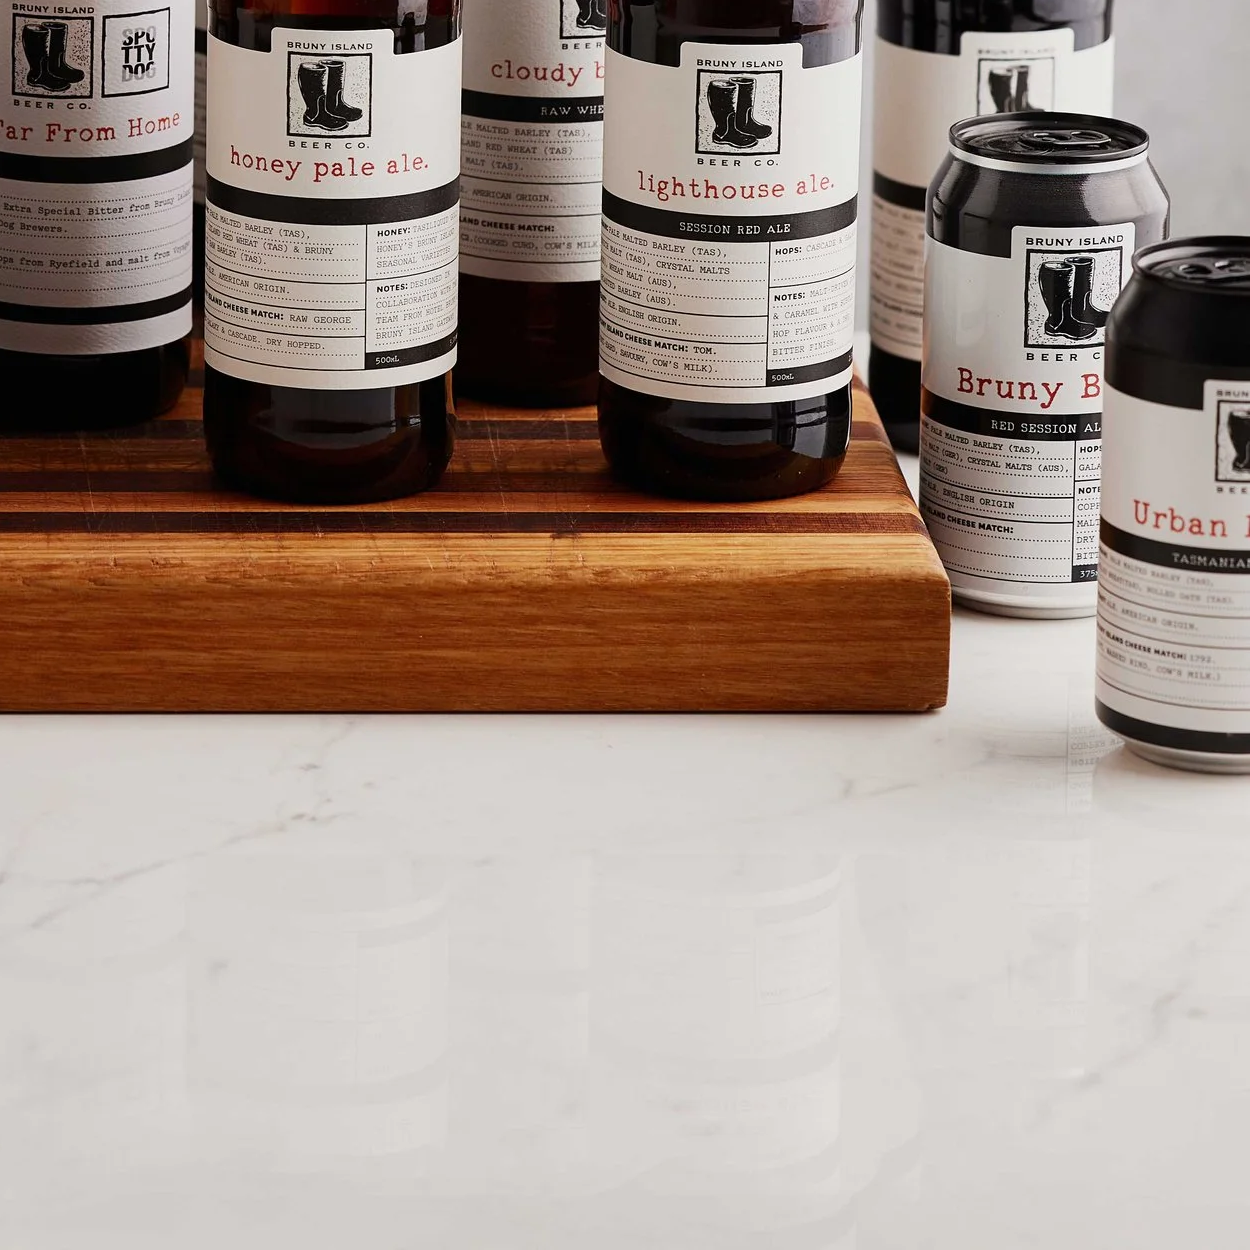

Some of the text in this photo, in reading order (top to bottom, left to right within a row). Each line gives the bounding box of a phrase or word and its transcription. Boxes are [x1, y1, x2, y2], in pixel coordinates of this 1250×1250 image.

[12, 3, 94, 14] BRUNY ISLAND
[121, 26, 156, 45] SPO
[121, 43, 155, 63] TTY
[697, 60, 737, 68] BRUNY
[121, 62, 156, 82] DOG
[491, 60, 583, 87] cloudy
[14, 99, 54, 109] BEER
[541, 105, 604, 115] RAW WHE
[46, 123, 115, 142] From
[127, 113, 180, 137] Home
[477, 124, 509, 135] MALTED
[515, 129, 550, 137] BARLEY
[289, 141, 332, 149] BEER
[230, 145, 428, 182] honey pale ale.
[698, 158, 741, 166] BEER
[638, 171, 835, 201] lighthouse ale.
[4, 202, 150, 217] Extra Special Bitter from
[20, 223, 68, 233] Brewers.
[482, 221, 515, 230] CHEESE
[679, 222, 791, 234] SESSION RED ALE
[377, 227, 411, 237] HONEY:
[1026, 235, 1123, 246] BRUNY ISLAND
[775, 247, 802, 255] HOPS:
[19, 257, 43, 267] from
[50, 259, 99, 269] Ryefield
[105, 258, 123, 266] and
[128, 255, 149, 265] malt
[656, 261, 694, 272] CRYSTAL
[377, 283, 408, 292] NOTES:
[774, 292, 805, 301] NOTES:
[251, 309, 284, 320] MATCH:
[290, 315, 308, 323] RAW
[648, 315, 681, 326] ORIGIN.
[266, 338, 325, 349] DRY HOPPED.
[655, 341, 716, 354] MATCH: TOM.
[1026, 353, 1078, 361] BEER
[957, 367, 1063, 408] Bruny
[991, 419, 1100, 433] RED SESSION AL
[973, 440, 1040, 454] BARLEY (TAS),
[967, 457, 1069, 472] CRYSTAL MALTS (AUS),
[979, 497, 1014, 508] ORIGIN
[947, 515, 1014, 533] CHEESE MATCH:
[1133, 499, 1227, 537] Urban
[1125, 641, 1151, 653] CHEESE
[1154, 649, 1186, 660] MATCH:
